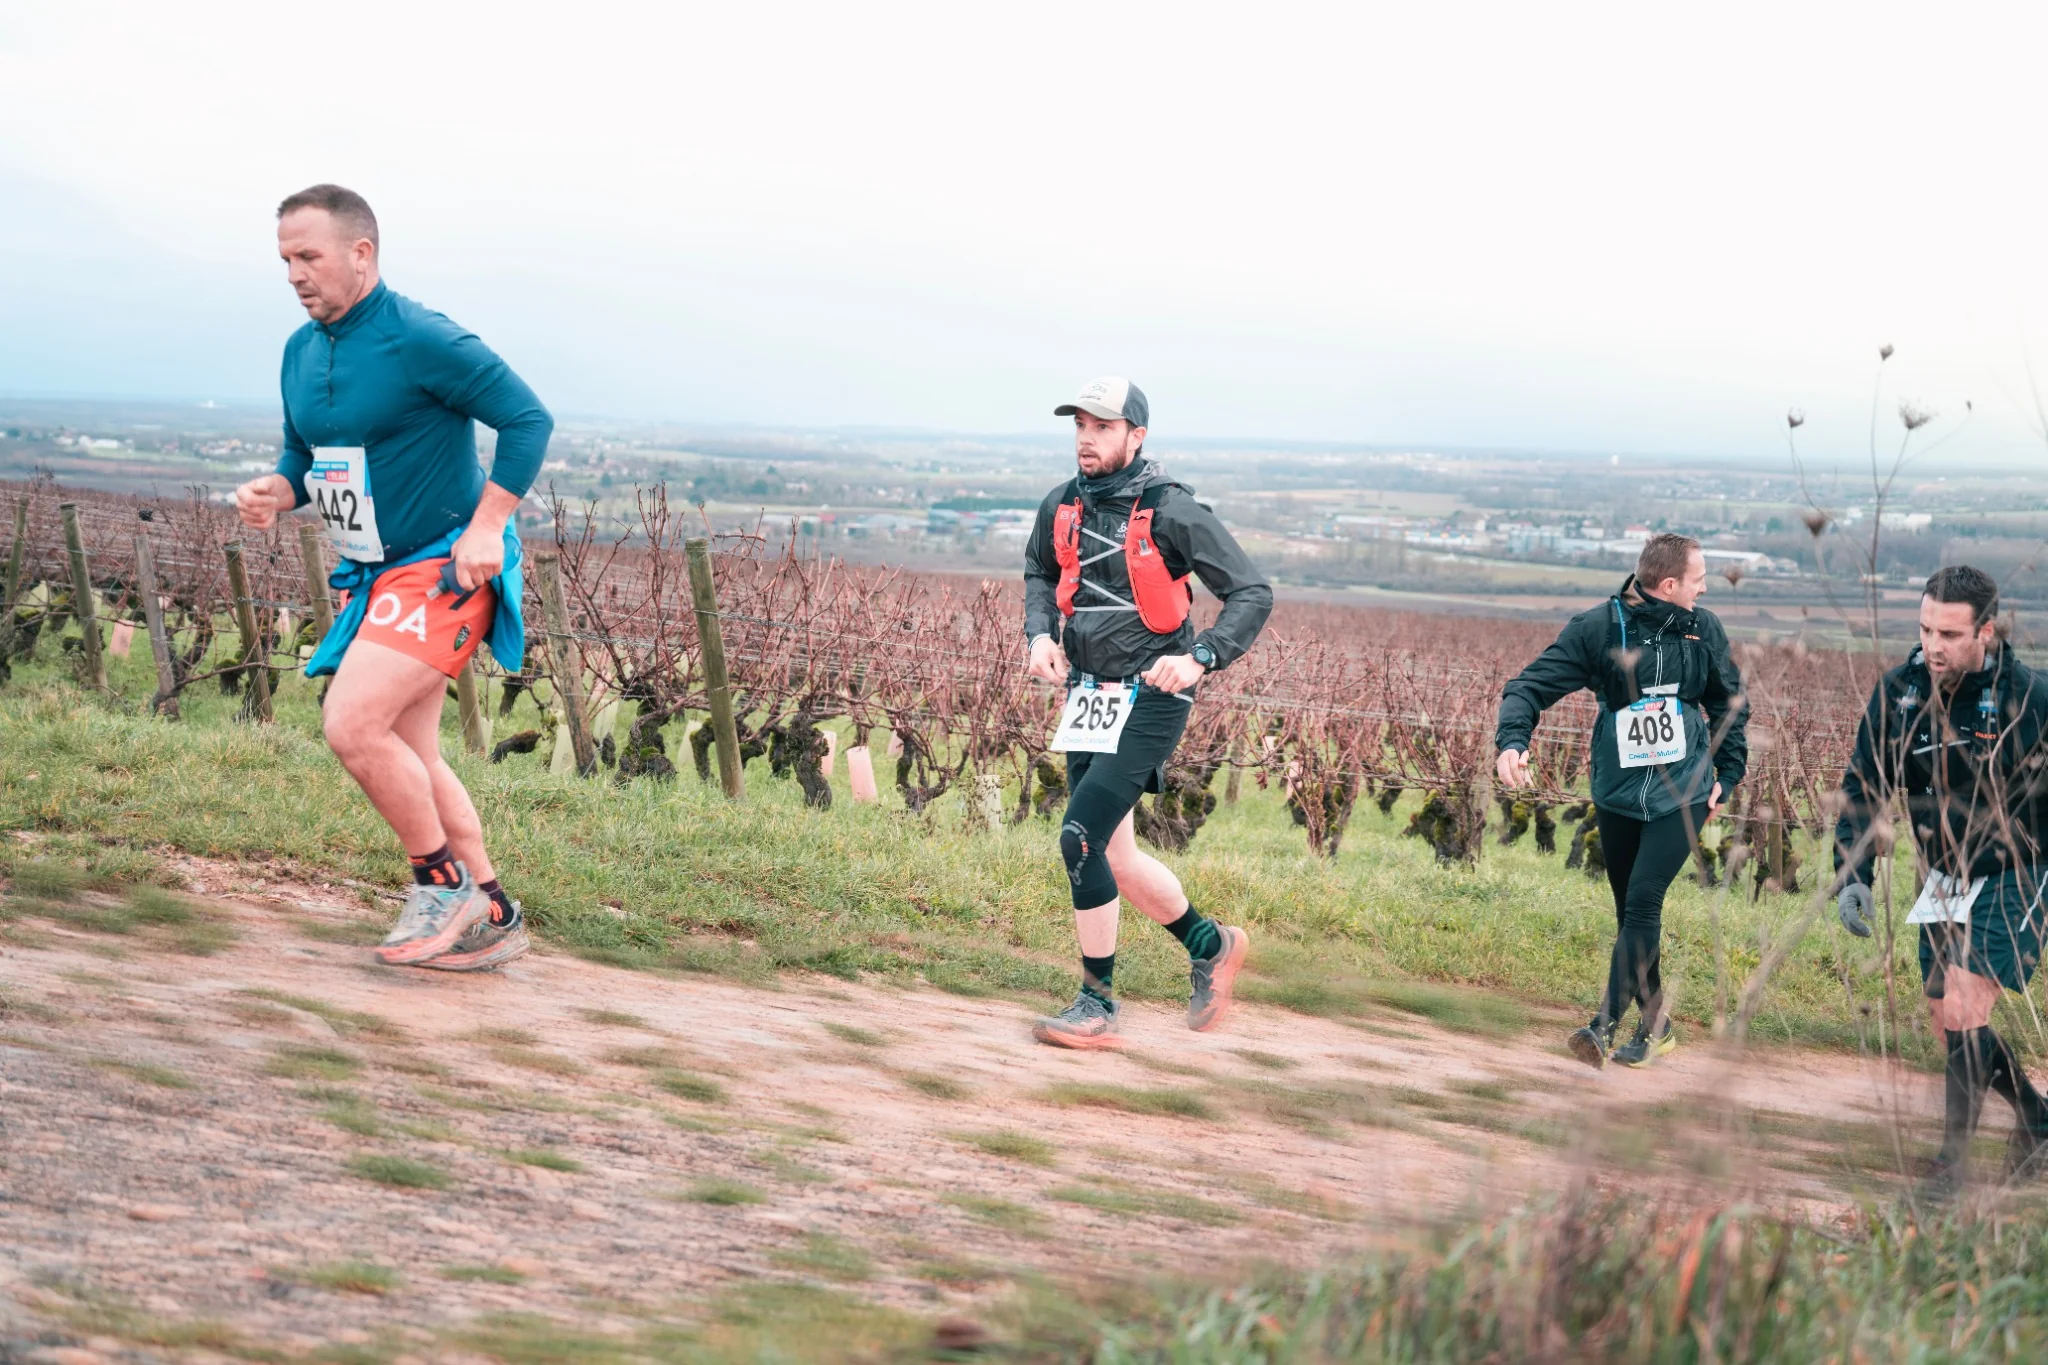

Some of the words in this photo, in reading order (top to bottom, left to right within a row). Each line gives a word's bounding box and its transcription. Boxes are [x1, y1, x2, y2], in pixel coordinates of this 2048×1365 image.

[317, 488, 362, 531] 442
[1069, 696, 1121, 731] 265
[1628, 712, 1674, 746] 408
[1657, 748, 1679, 757] Mutuel
